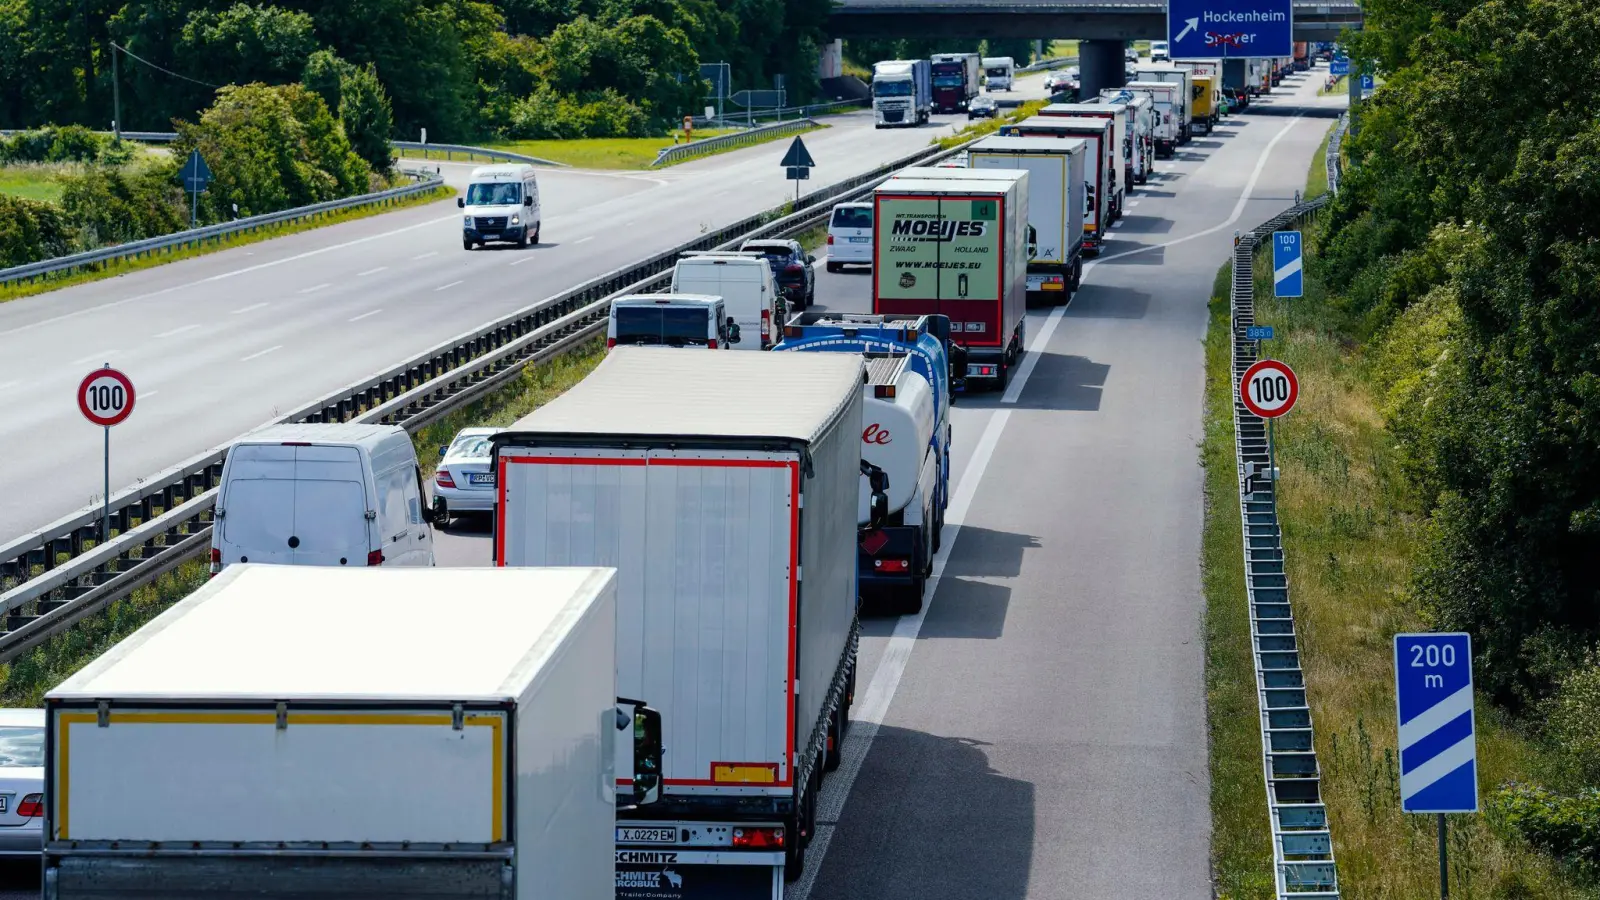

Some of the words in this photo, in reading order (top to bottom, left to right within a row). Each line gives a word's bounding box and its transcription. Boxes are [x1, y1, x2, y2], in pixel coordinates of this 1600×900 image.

[1203, 9, 1286, 23] Hockenheim
[1363, 76, 1371, 88] P
[1279, 234, 1296, 244] 100
[889, 245, 916, 253] ZWAAG
[954, 246, 989, 254] HOLLAND
[895, 261, 982, 270] WWW.MOEIJES.EU
[1252, 375, 1288, 403] 100
[89, 385, 124, 411] 100
[1410, 644, 1456, 667] 200
[1425, 674, 1444, 688] m
[615, 852, 678, 863] SCHMITZ
[615, 871, 661, 881] CHMITZ
[613, 880, 661, 888] ARGOBULL
